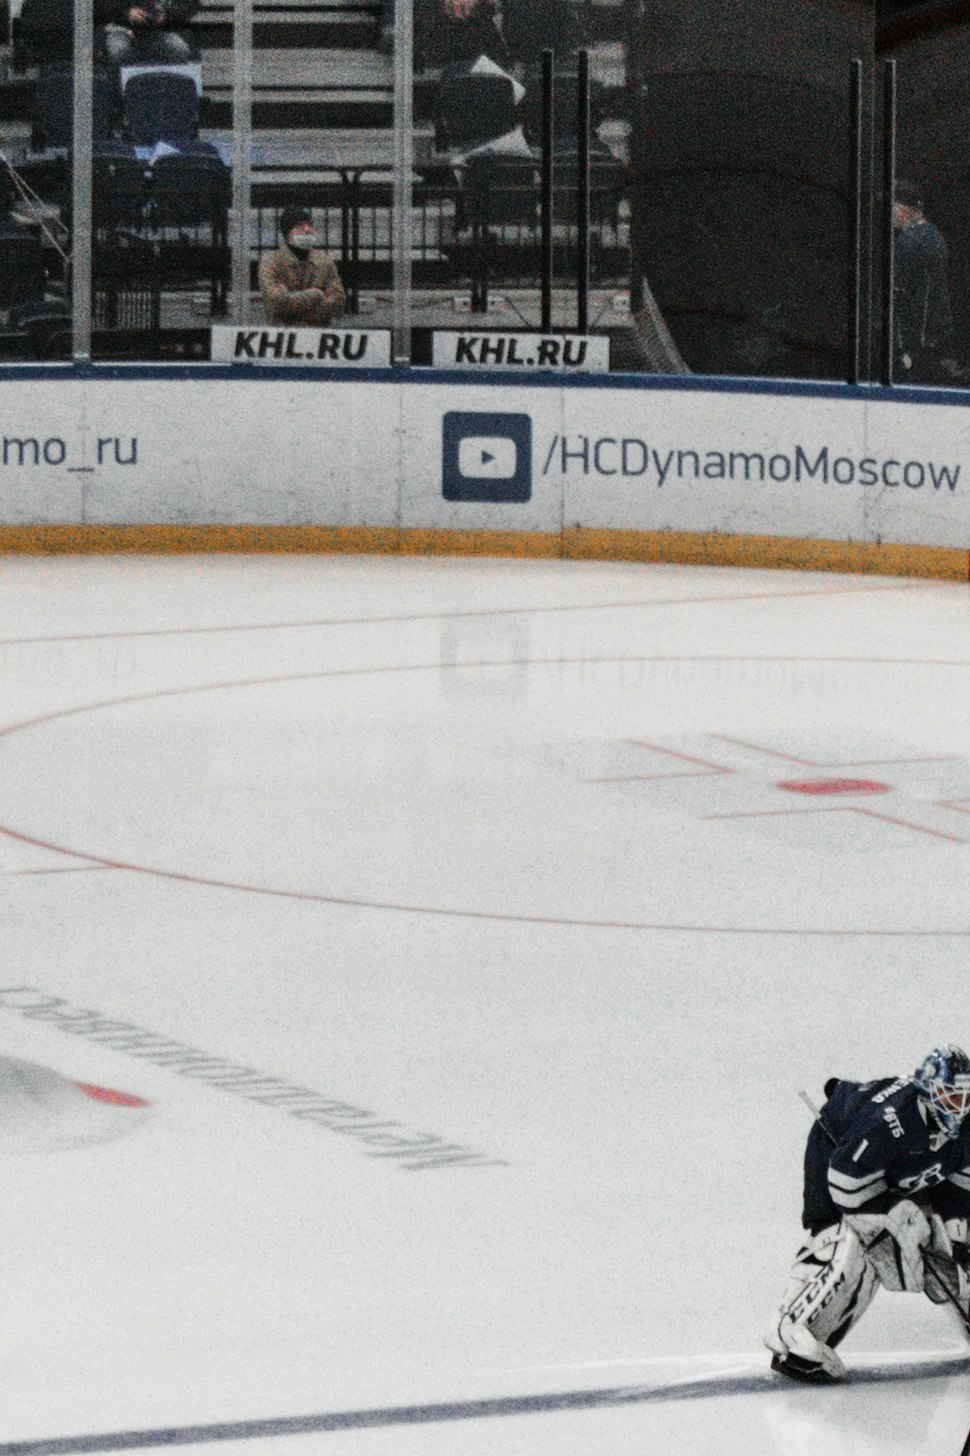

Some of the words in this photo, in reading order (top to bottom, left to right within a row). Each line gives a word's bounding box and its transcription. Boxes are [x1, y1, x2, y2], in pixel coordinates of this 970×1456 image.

[233, 331, 368, 361] KHL.RU
[455, 337, 588, 367] KHL.RU
[543, 434, 961, 491] /HCDynamoMoscow
